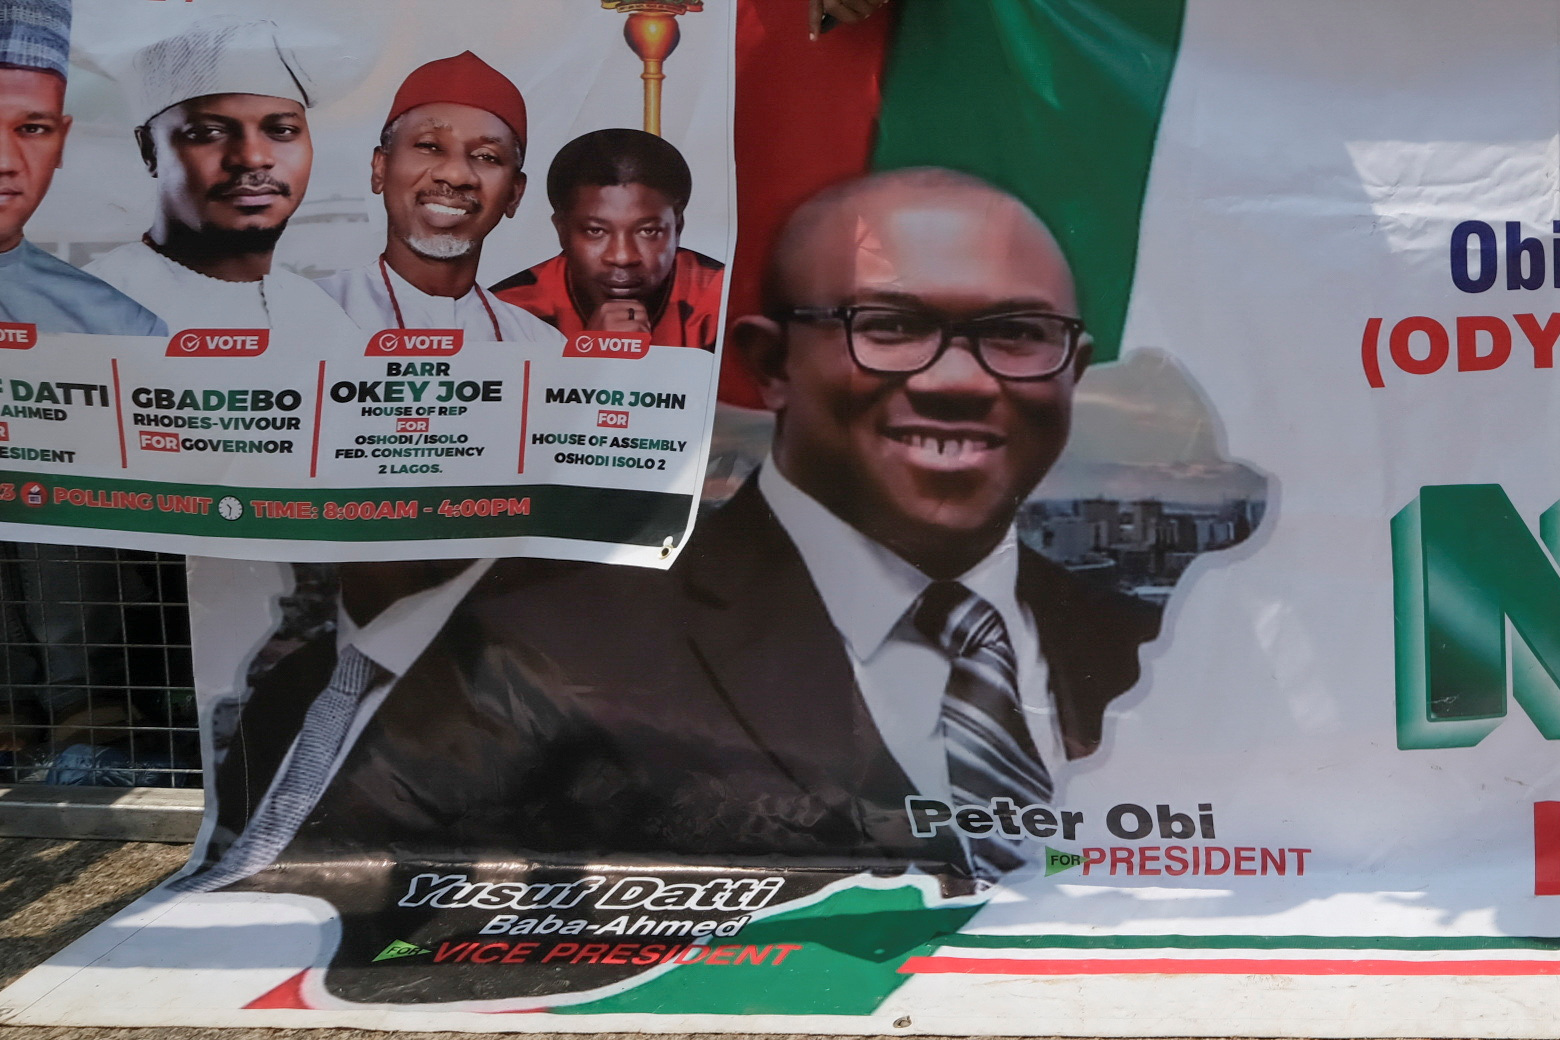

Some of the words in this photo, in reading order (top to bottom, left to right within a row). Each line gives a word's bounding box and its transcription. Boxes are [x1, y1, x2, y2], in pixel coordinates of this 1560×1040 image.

[206, 336, 259, 350] VOTE
[403, 335, 454, 350] VOTE
[598, 337, 642, 352] VOTE
[386, 362, 450, 377] BARR
[10, 379, 110, 408] DATTI
[131, 386, 302, 412] GBADEBO
[330, 380, 430, 403] OKEY
[435, 380, 502, 402] JOE
[545, 388, 624, 407] MAYOR
[628, 390, 686, 410] JOHN
[361, 406, 412, 417] HOUSE
[416, 406, 436, 416] OF
[437, 406, 467, 416] REP
[598, 412, 628, 426] FOR
[133, 413, 301, 431] RHODES-VIVOUR
[397, 421, 427, 431] FOR
[141, 434, 178, 450] FOR
[181, 437, 293, 454] GOVERNOR
[335, 447, 368, 459] FED.
[371, 446, 485, 458] CONSTITUENCY
[532, 433, 586, 446] HOUSE
[588, 434, 608, 447] OF
[609, 436, 687, 453] ASSEMBLY
[378, 464, 387, 474] 2
[390, 464, 443, 474] LAGOS.
[554, 452, 610, 467] OSHODI
[612, 456, 655, 469] ISOLO
[656, 459, 666, 470] 2
[53, 486, 154, 510] POLLING
[157, 494, 213, 515] UNIT
[251, 500, 320, 520] TIME:
[323, 500, 418, 521] 8:00AM
[437, 497, 531, 517] 4:00PM
[905, 794, 1084, 841] Peter
[1105, 802, 1216, 841] Obi
[1050, 854, 1082, 867] FOR
[1082, 846, 1312, 877] PRESIDENT
[397, 872, 601, 910] Yusuf
[596, 875, 786, 912] Datti
[478, 913, 753, 938] Baba-Ahmed
[386, 944, 421, 957] FOR
[432, 941, 542, 965] VICE
[555, 941, 804, 966] PRESIDENT
